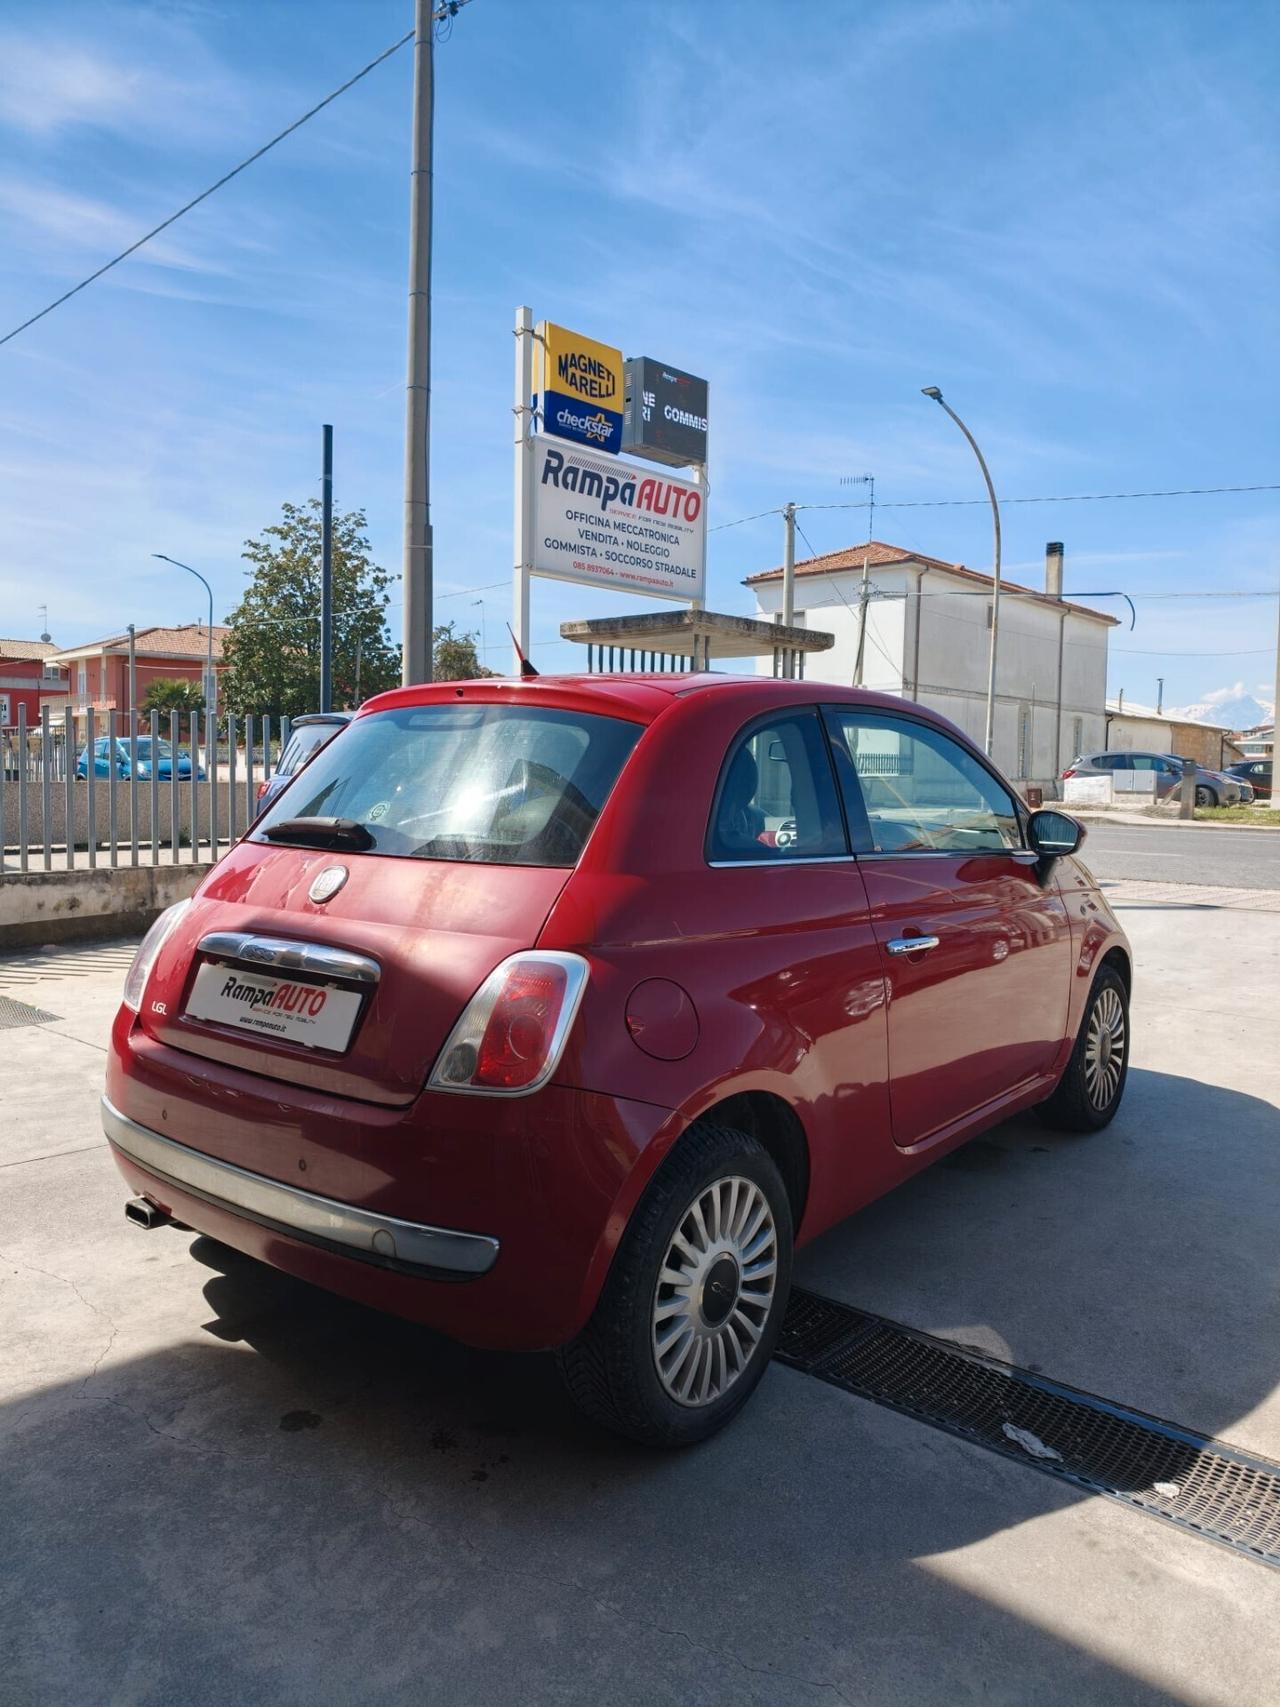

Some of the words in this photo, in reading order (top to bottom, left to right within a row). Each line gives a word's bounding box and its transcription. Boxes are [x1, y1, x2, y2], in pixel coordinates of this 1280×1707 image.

[558, 353, 615, 390] MAGNETI
[558, 358, 615, 398] MARELLI
[557, 409, 614, 437] checkstar
[664, 405, 708, 431] GOMMIS
[566, 510, 611, 528] OFFICINA
[613, 521, 680, 545] MECCATRONICA
[578, 528, 619, 546] VENDITA
[626, 540, 670, 558] NOLEGGIO
[544, 538, 597, 558] GOMMISTA
[605, 550, 653, 569] SOCCORSO
[655, 563, 697, 579] STRADALE
[573, 561, 585, 571] 085
[586, 564, 615, 575] 8937064
